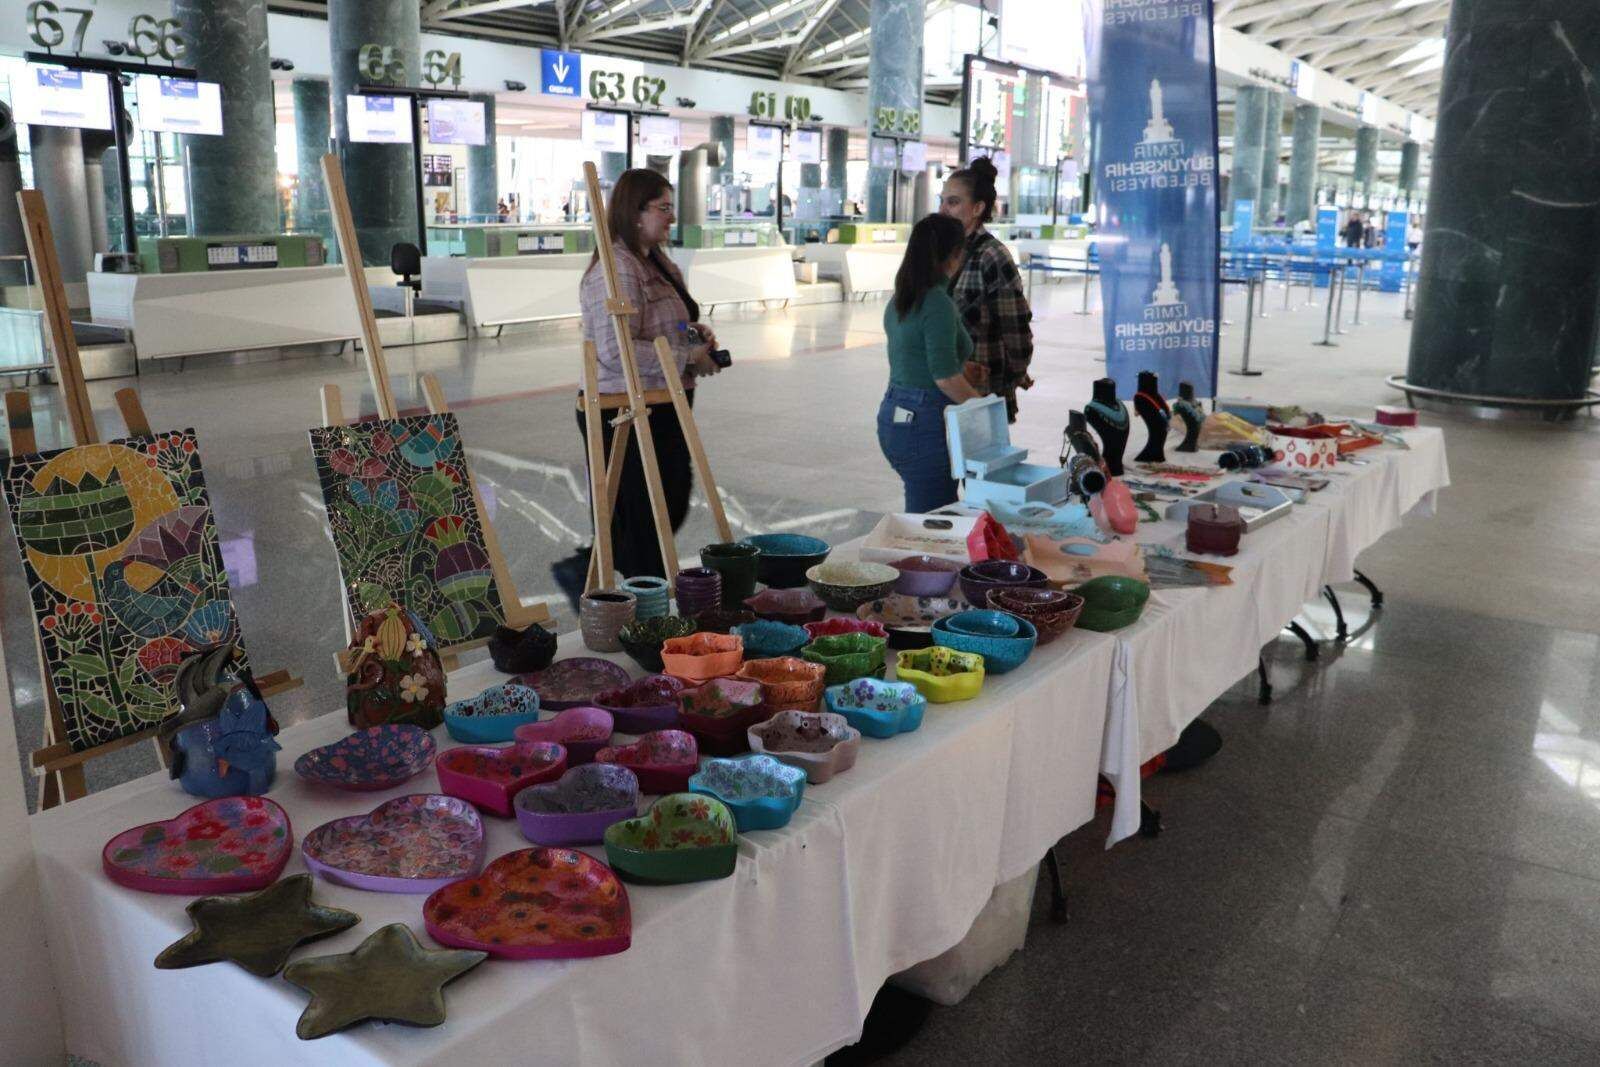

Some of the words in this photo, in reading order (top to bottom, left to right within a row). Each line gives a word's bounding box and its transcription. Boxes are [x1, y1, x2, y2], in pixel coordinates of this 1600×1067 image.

[26, 0, 93, 53] 67
[128, 14, 187, 61] 66
[423, 49, 462, 86] 64
[589, 70, 625, 101] 63
[632, 75, 666, 106] 62
[750, 91, 776, 118] 61
[874, 107, 896, 130] 59
